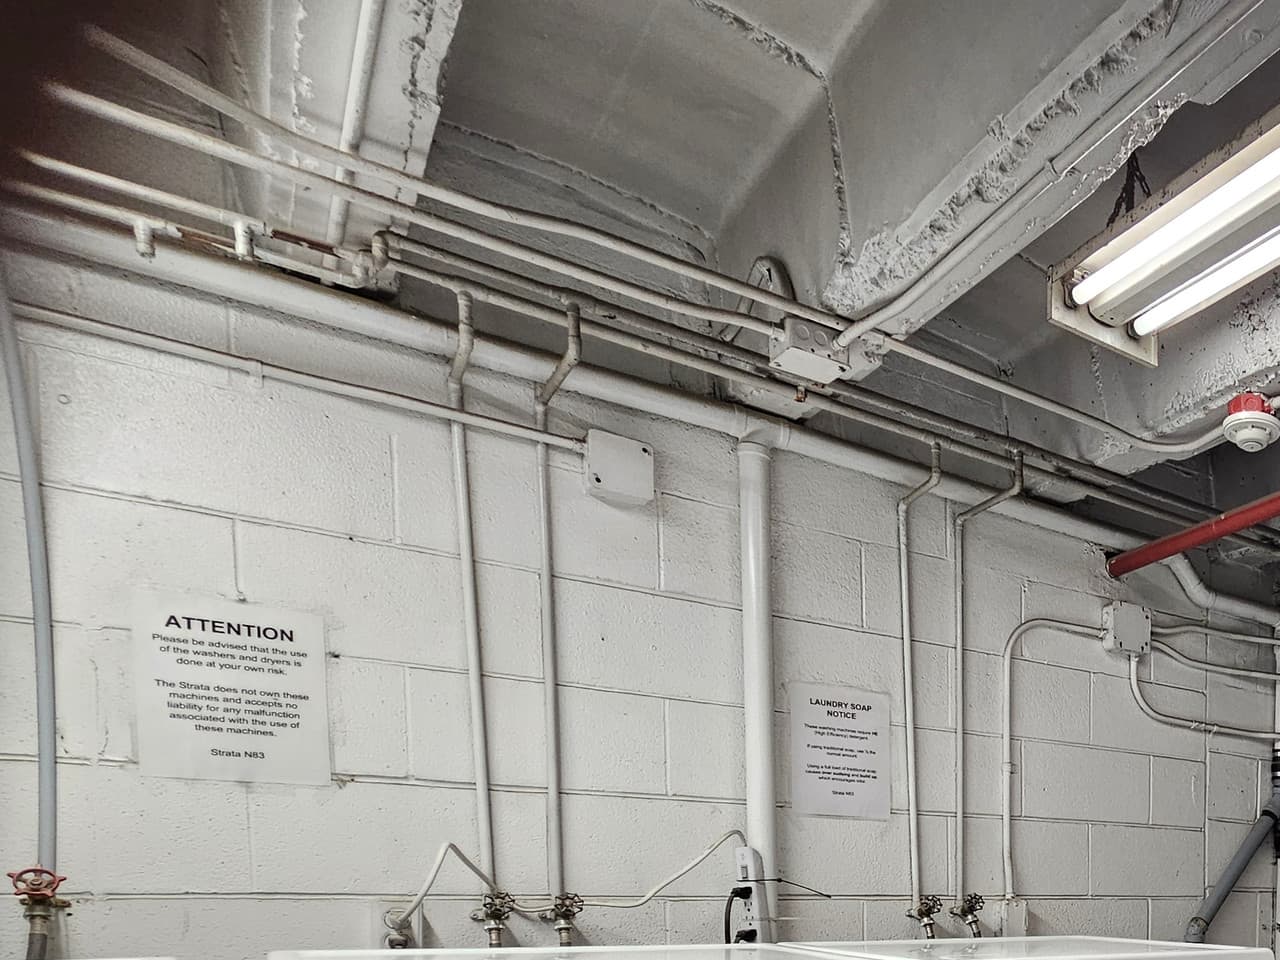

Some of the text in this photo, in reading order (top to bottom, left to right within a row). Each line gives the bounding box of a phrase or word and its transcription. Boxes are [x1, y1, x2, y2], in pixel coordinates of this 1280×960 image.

[165, 615, 294, 642] ATTENTION
[152, 633, 189, 645] Please
[192, 638, 205, 646] be
[208, 640, 248, 651] advised
[250, 645, 270, 654] that
[272, 647, 288, 656] the
[159, 645, 170, 653] of
[173, 646, 189, 655] the
[192, 650, 236, 660] washers
[239, 654, 258, 662] and
[260, 656, 291, 667] dryers
[176, 657, 288, 676] done at your own risk.
[154, 678, 310, 701] The Strata does not own these
[168, 691, 298, 710] machines and accepts no
[809, 697, 872, 711] LAUNDRY SOAP
[166, 701, 301, 719] liability for any malfunction
[169, 712, 225, 723] associated
[228, 716, 249, 725] with
[251, 718, 267, 726] the
[827, 710, 857, 719] NOTICE
[194, 724, 277, 737] these machines.
[210, 748, 265, 759] Strata N83
